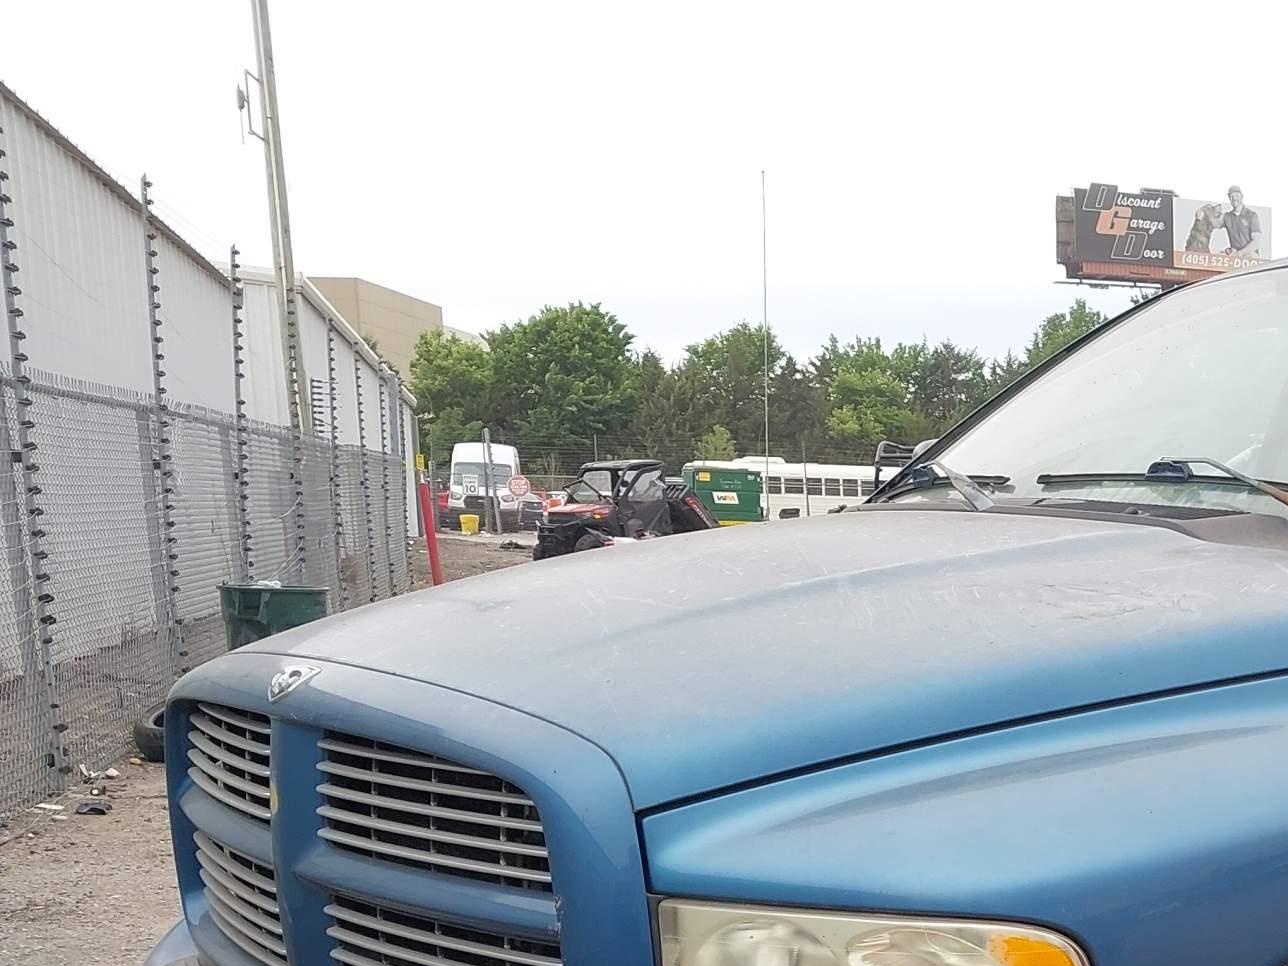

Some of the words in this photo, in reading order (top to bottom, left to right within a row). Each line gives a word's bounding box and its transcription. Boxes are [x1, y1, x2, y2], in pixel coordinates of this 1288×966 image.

[1083, 183, 1161, 211] Discount
[1096, 207, 1165, 236] Garage
[1111, 231, 1165, 260] Door
[1182, 254, 1208, 265] (405)
[1210, 256, 1264, 269] 525-DOO
[465, 485, 476, 493] 10
